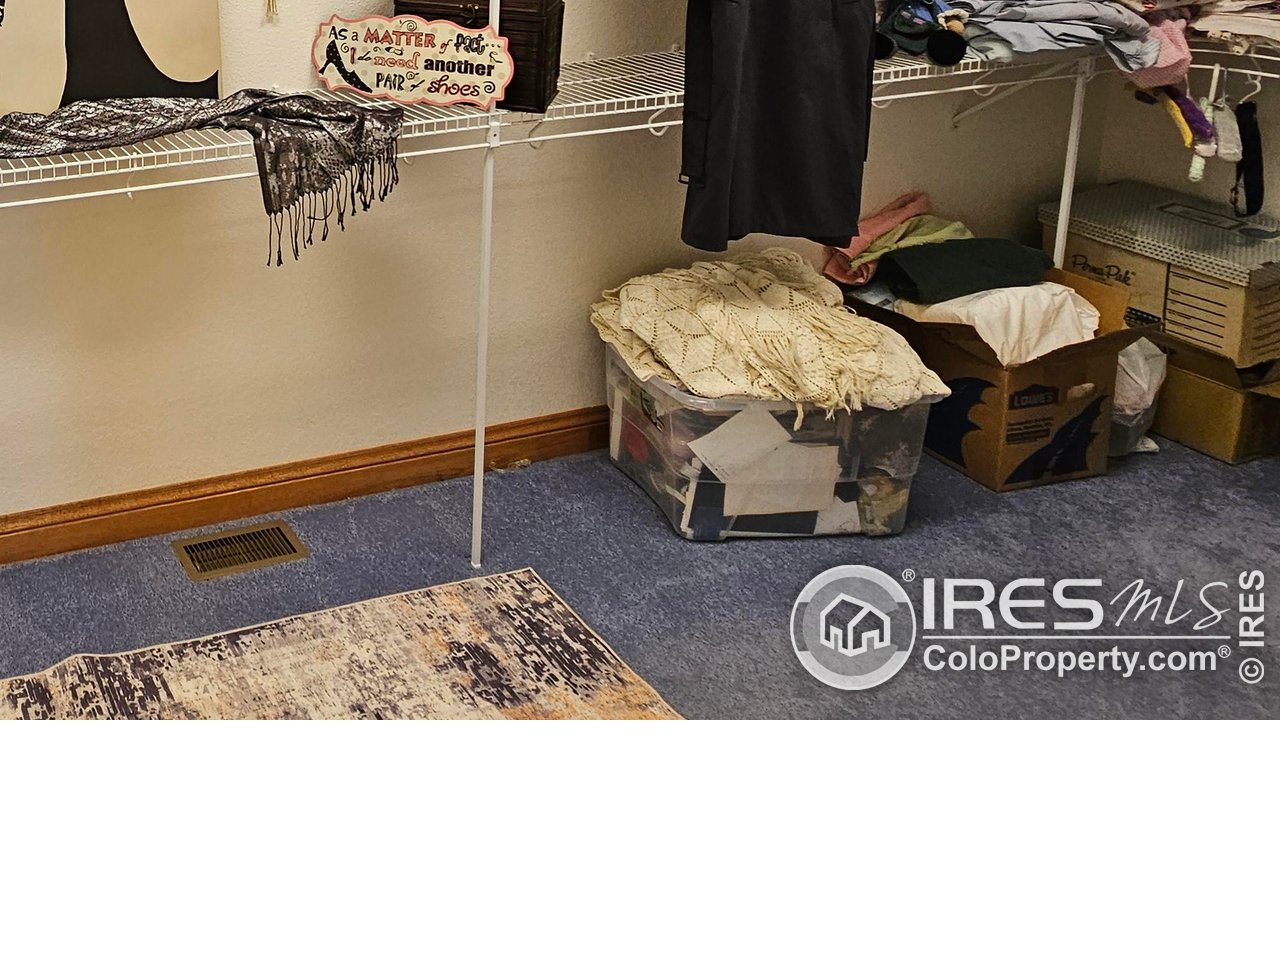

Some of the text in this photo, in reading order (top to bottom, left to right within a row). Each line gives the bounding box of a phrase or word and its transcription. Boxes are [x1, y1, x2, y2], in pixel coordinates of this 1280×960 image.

[351, 31, 359, 41] a
[363, 26, 437, 48] MATTER
[439, 39, 453, 54] of
[349, 47, 495, 77] I do need another
[375, 72, 481, 97] PAIR of shoes
